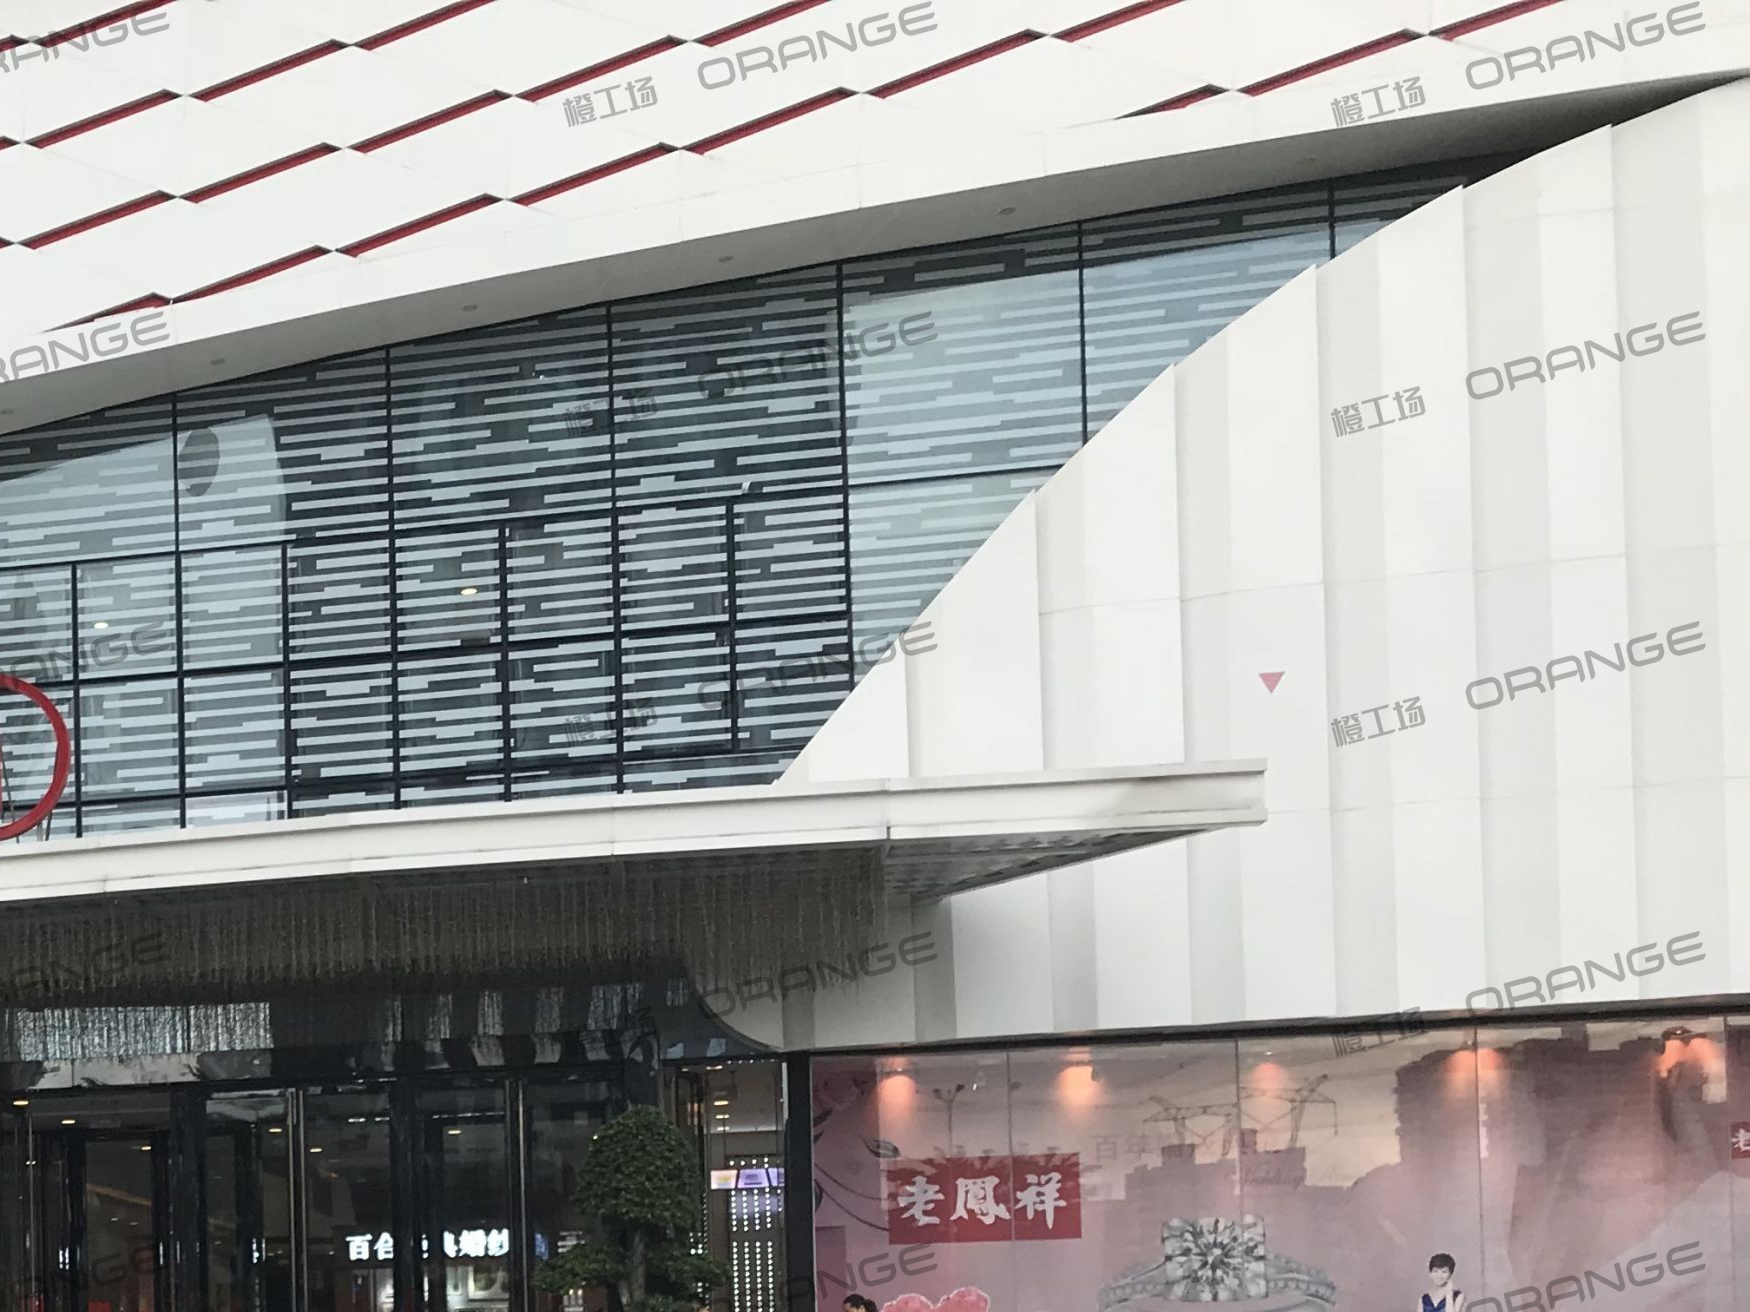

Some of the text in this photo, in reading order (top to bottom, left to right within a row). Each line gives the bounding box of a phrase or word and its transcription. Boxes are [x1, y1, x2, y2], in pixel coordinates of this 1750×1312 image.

[897, 1172, 1067, 1230] 老鳳祥
[345, 1228, 510, 1261] 百合婚纱
